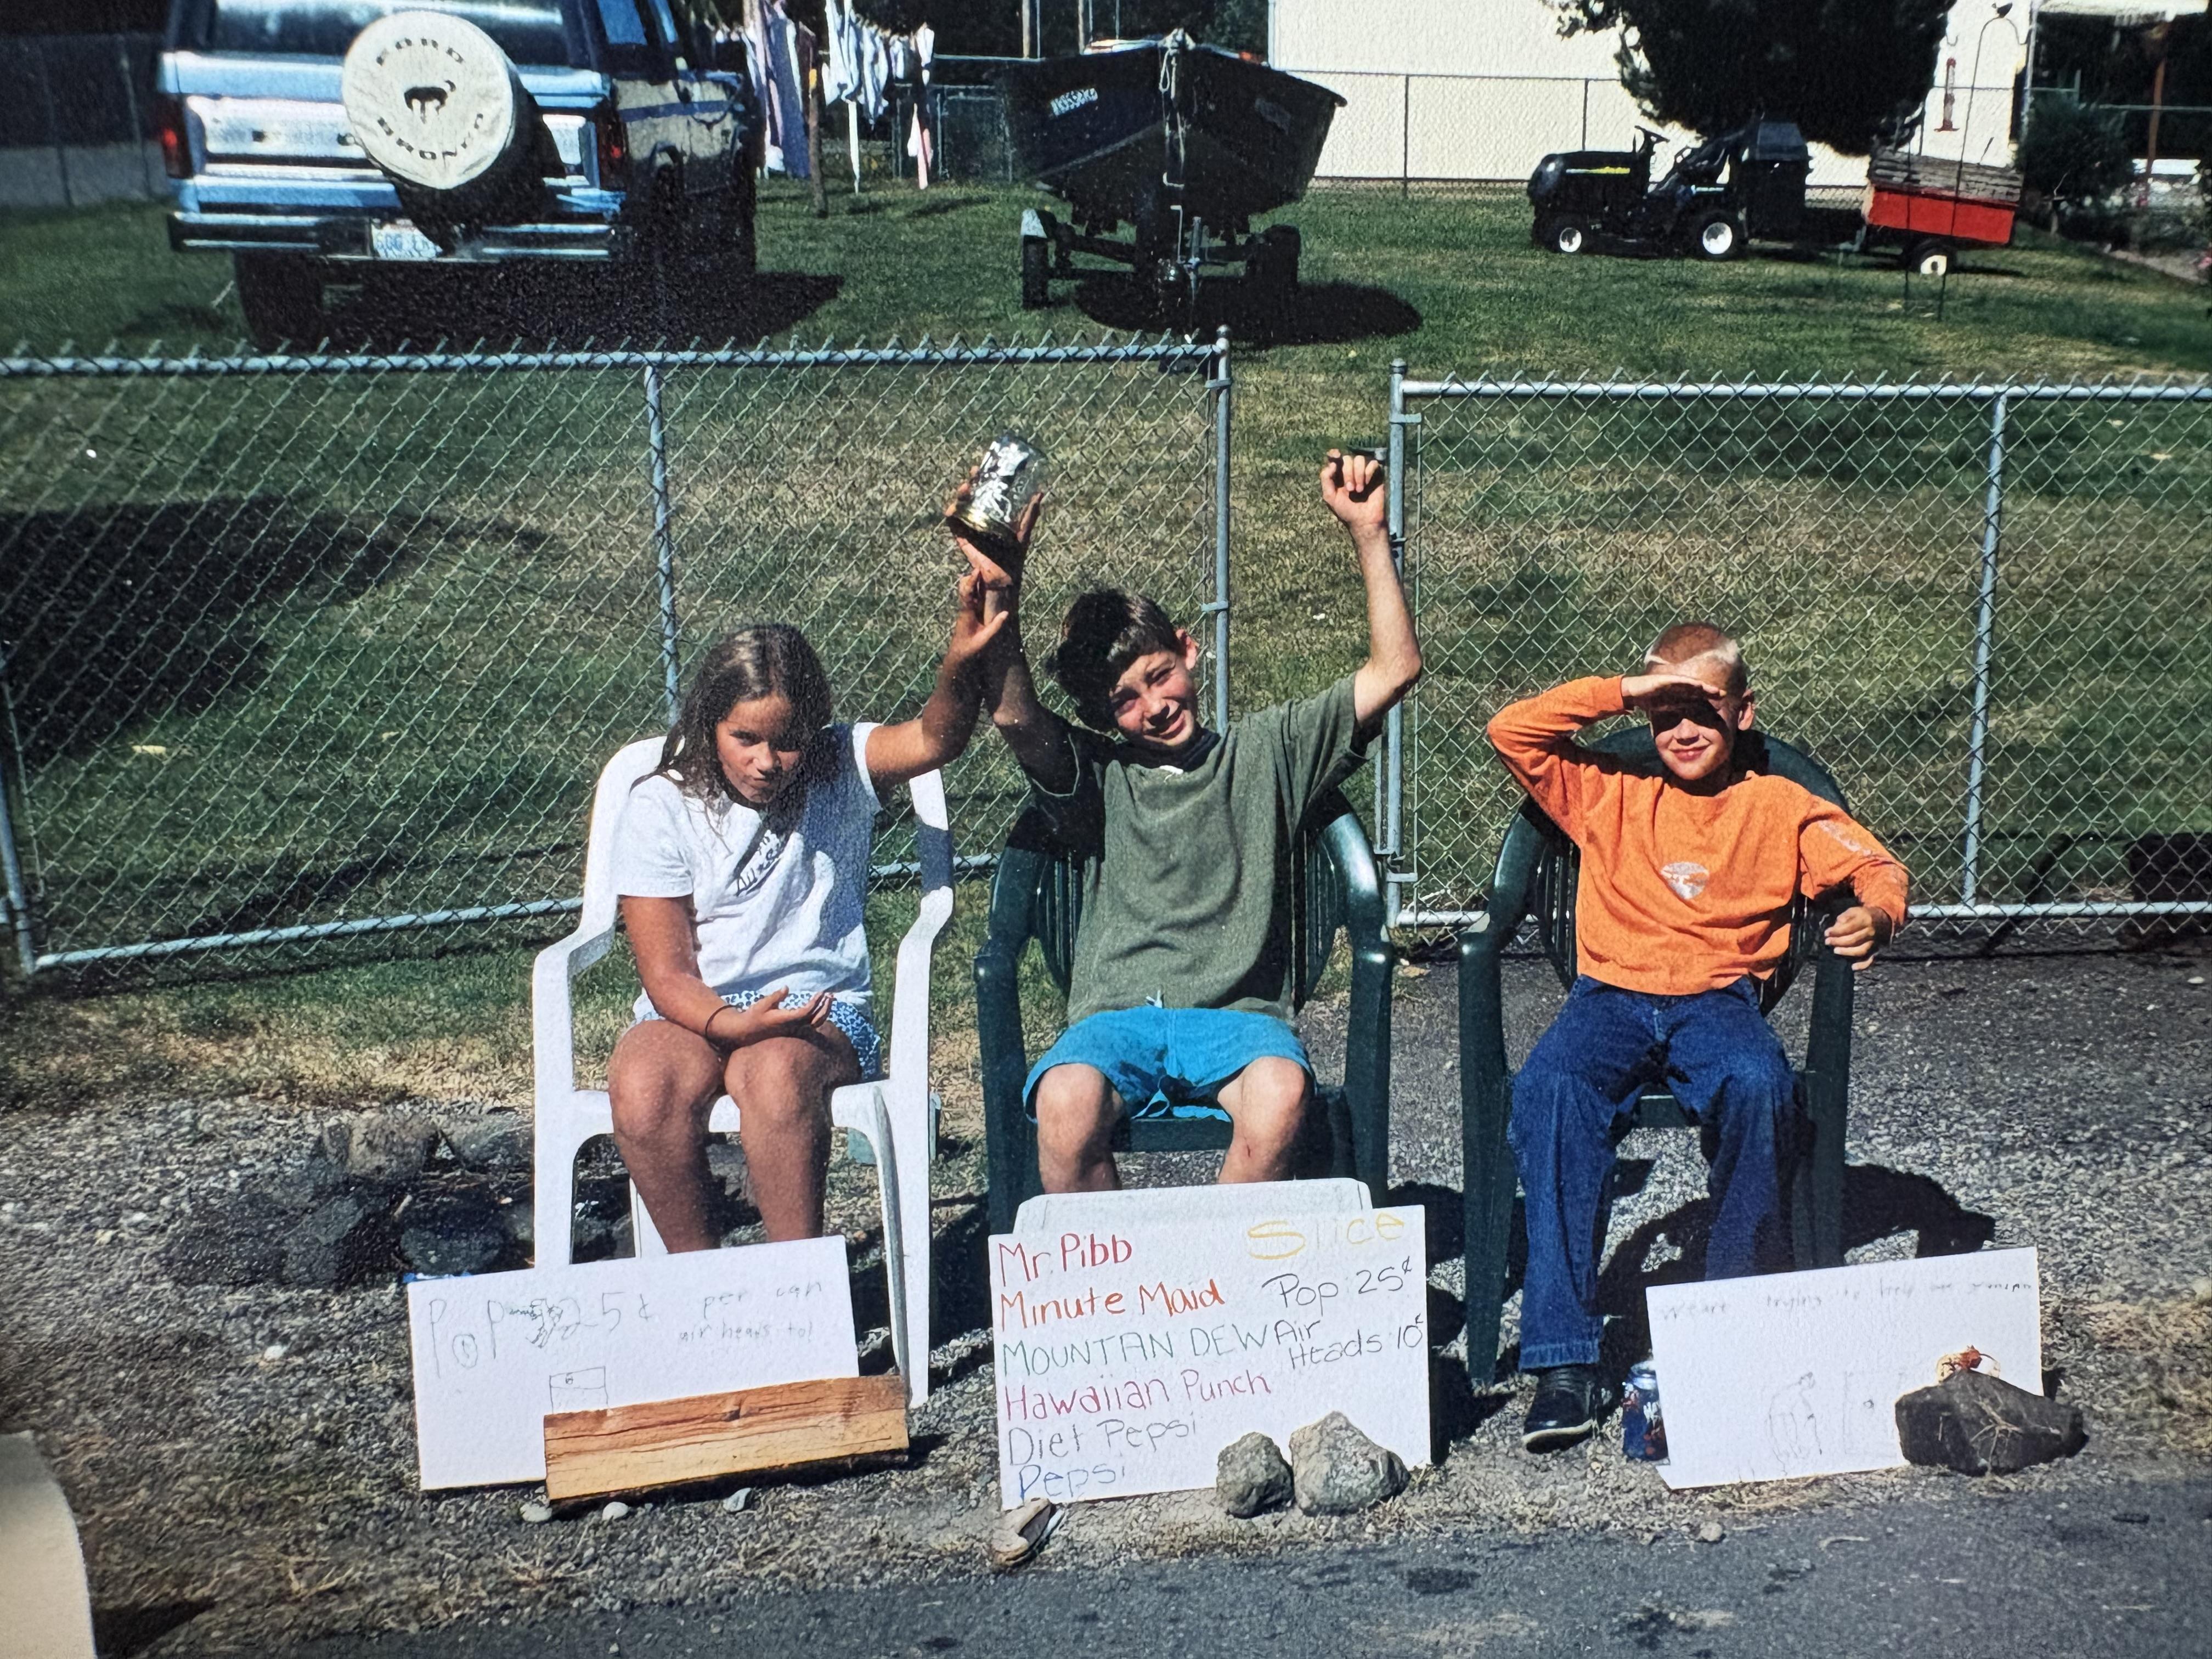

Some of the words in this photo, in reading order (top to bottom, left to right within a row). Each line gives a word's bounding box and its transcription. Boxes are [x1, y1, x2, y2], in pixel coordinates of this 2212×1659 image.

[1060, 1232, 1133, 1272] Pibb
[1246, 1211, 1406, 1261] Slice
[1000, 1286, 1126, 1332] Minute
[1138, 1278, 1226, 1318] Maid
[1261, 1272, 1339, 1317] Pop
[1356, 1255, 1413, 1294] 25¢
[1189, 1322, 1268, 1357] DEW
[1273, 1318, 1322, 1346] Air
[1288, 1328, 1384, 1370] Heads
[1004, 1374, 1171, 1421] Hawaiian
[1180, 1368, 1272, 1402] Punch
[1008, 1423, 1085, 1466] Diet
[1096, 1410, 1198, 1453] Pepsi
[1018, 1456, 1126, 1500] Pepsi
